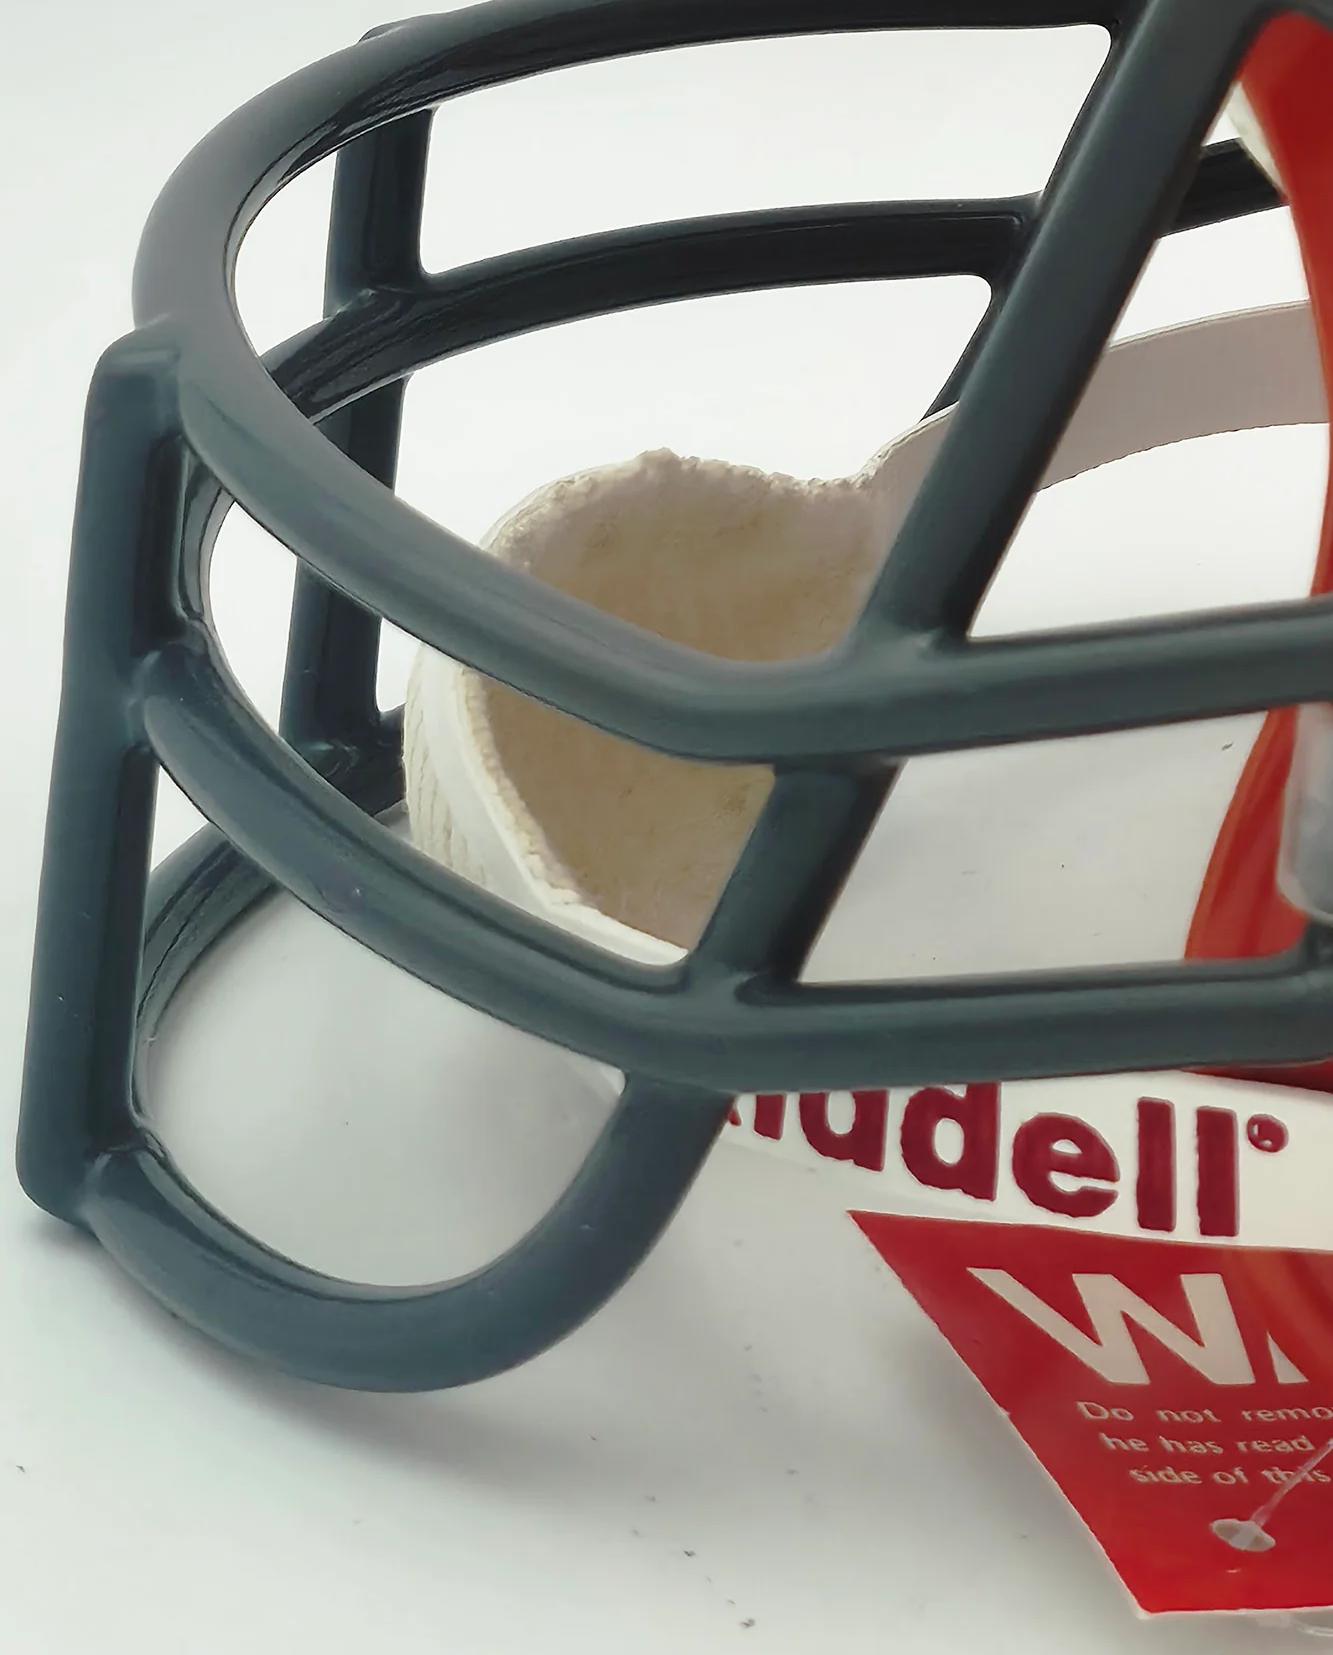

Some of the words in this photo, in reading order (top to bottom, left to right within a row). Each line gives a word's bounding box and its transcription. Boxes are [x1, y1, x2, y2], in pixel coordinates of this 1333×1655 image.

[1076, 1401, 1135, 1422] Do
[1156, 1407, 1222, 1424] not
[1099, 1431, 1150, 1452] he
[1158, 1434, 1225, 1456] has
[1234, 1434, 1316, 1453] read
[1128, 1463, 1204, 1485] side
[1212, 1466, 1250, 1486] of
[1260, 1466, 1333, 1485] this
